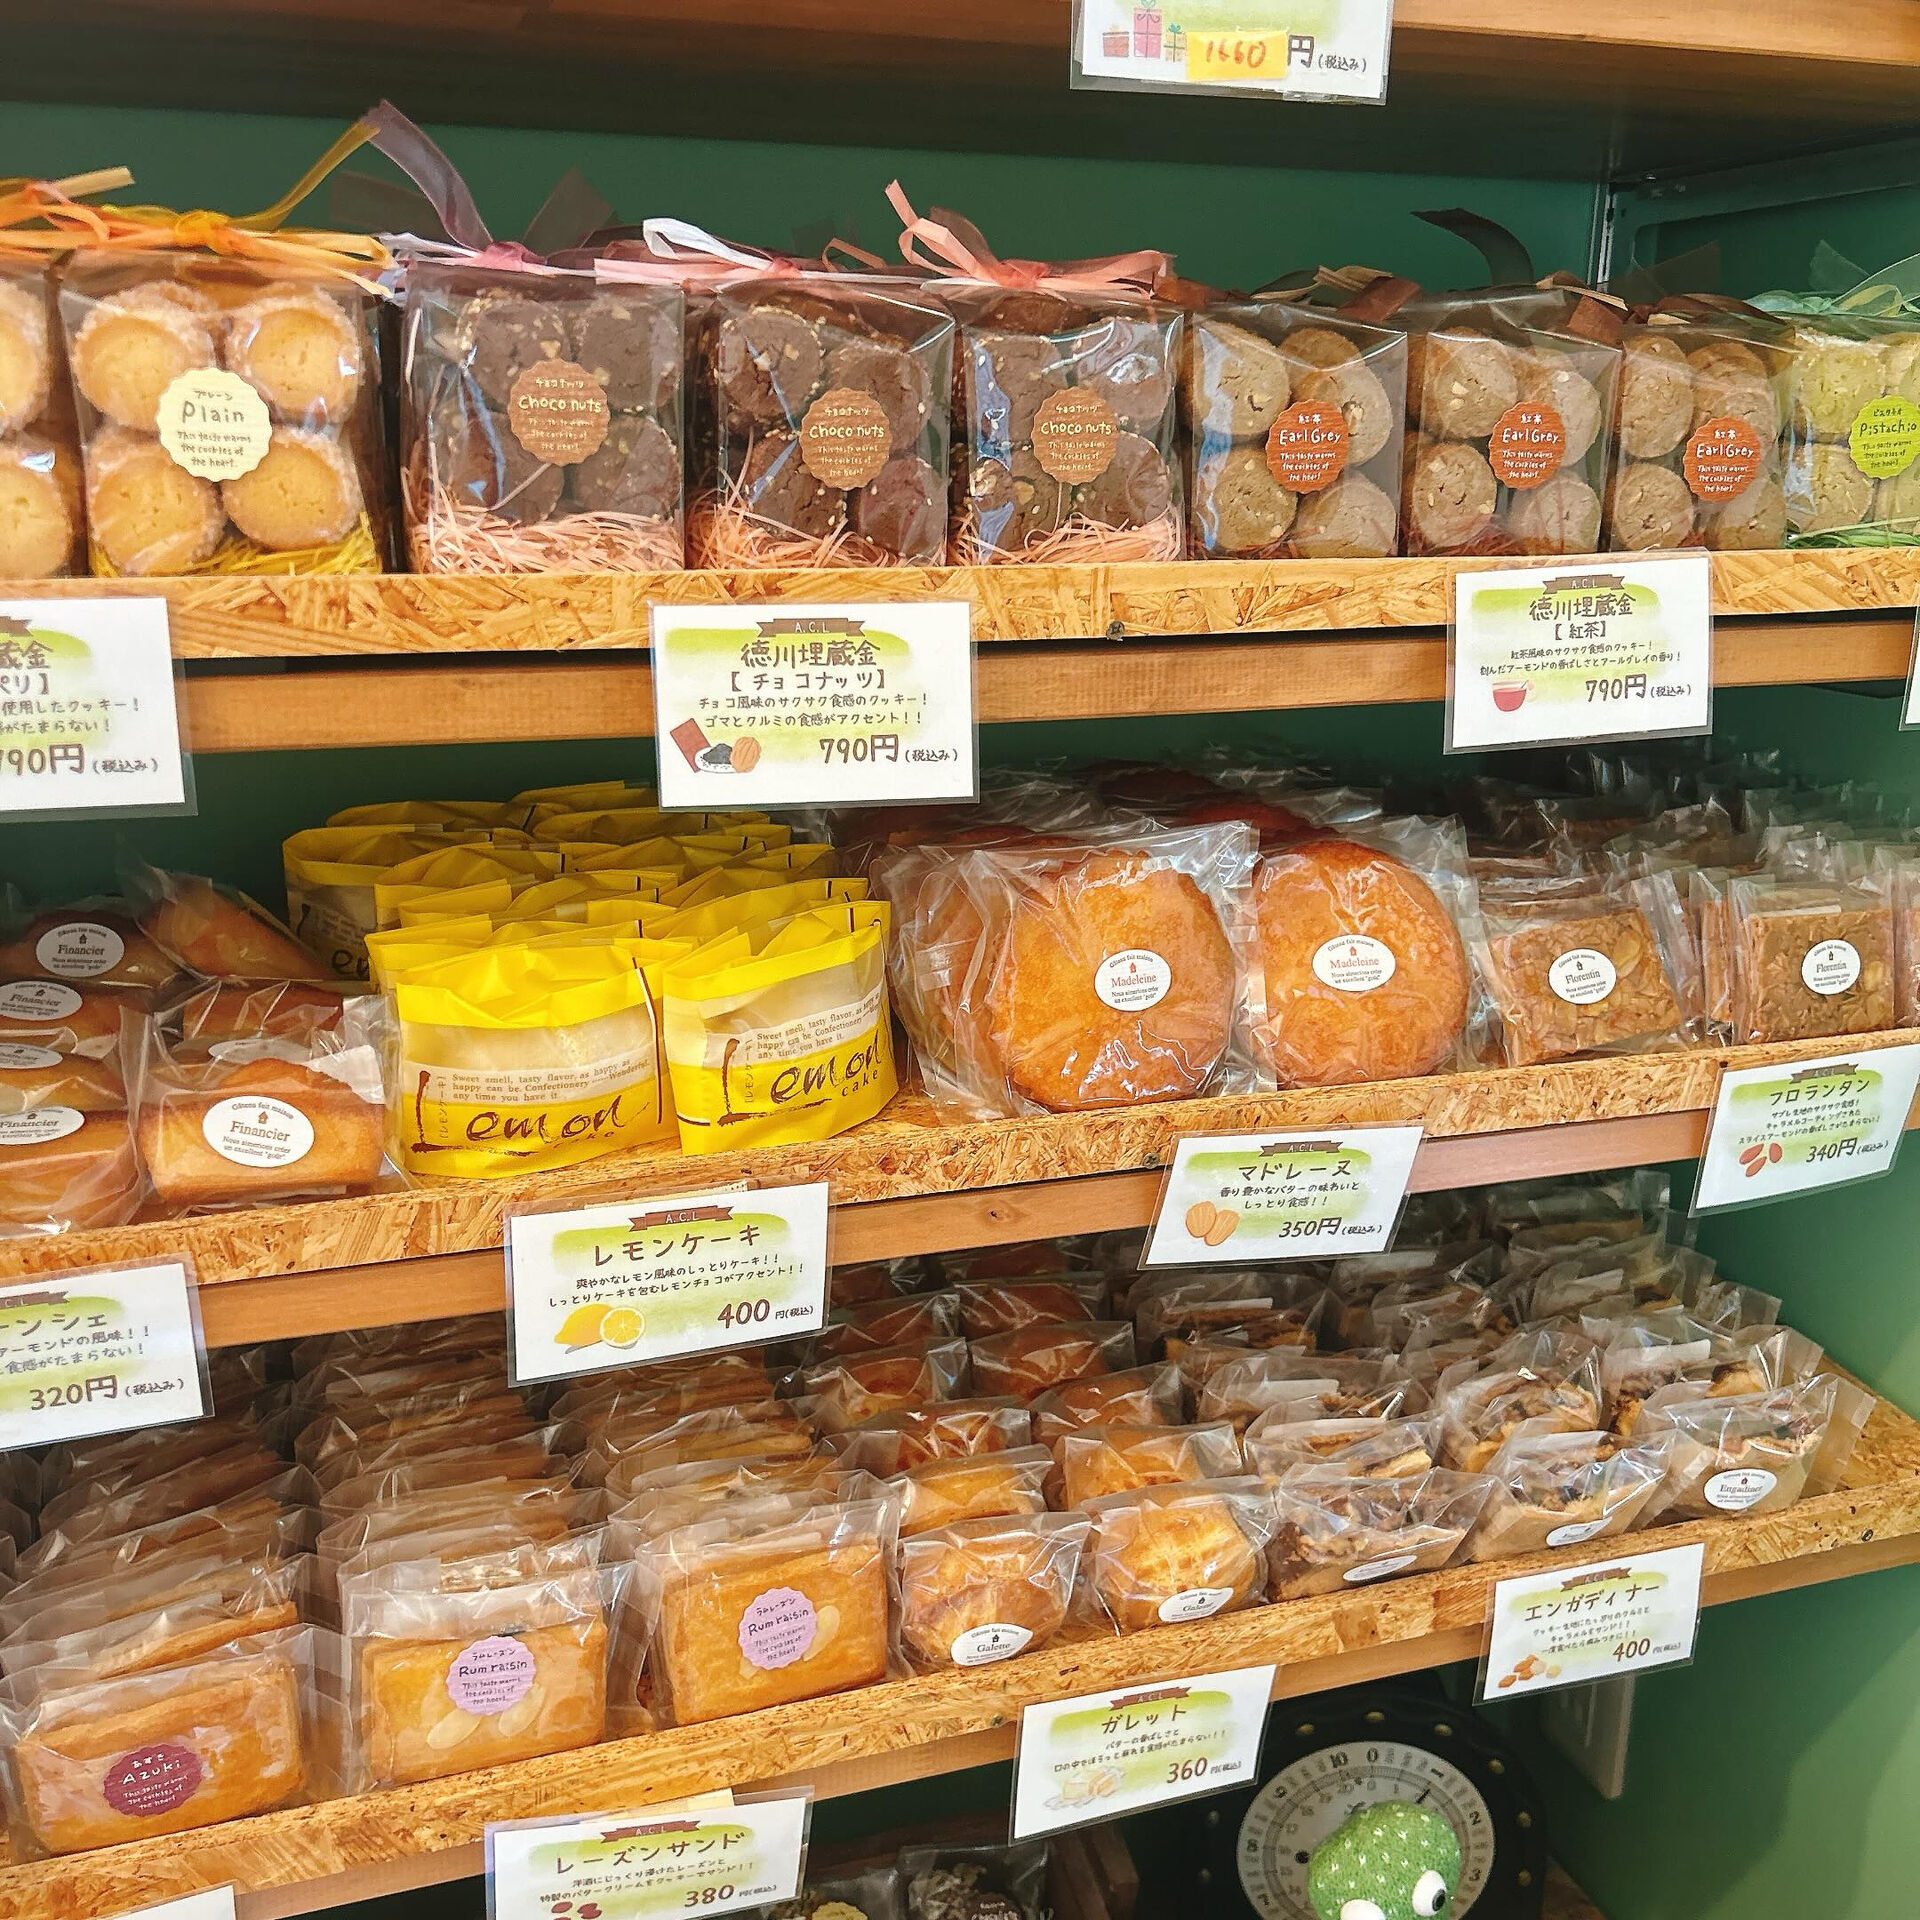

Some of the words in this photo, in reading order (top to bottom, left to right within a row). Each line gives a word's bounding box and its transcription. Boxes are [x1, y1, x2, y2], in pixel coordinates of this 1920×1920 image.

[182, 400, 245, 423] Plain
[571, 398, 602, 413] nuts
[857, 424, 884, 438] nuts
[1085, 421, 1112, 435] nuts
[1279, 428, 1308, 445] Earl
[1311, 428, 1342, 444] Grey
[1502, 427, 1529, 443] Earl
[1531, 428, 1560, 444] Grey
[1860, 420, 1917, 437] Pistachio
[1696, 442, 1724, 458] Earl
[1725, 443, 1755, 458] Grey
[1528, 593, 1637, 623] 徳川埋蔵金
[1555, 620, 1607, 641] 【紅茶】
[740, 639, 881, 669] 徳川埋蔵金
[699, 692, 929, 710] チョコ風味のサクサク食感のクッキー！
[0, 719, 110, 734] がたまらない！
[703, 711, 923, 729] ゴマとクルミの食感がアクセント！！
[1329, 958, 1380, 969] Madeleine
[1111, 974, 1157, 988] Madeleine
[757, 1032, 782, 1040] Sweet
[808, 1017, 827, 1029] tasty
[757, 1040, 784, 1051] happy
[788, 1037, 800, 1047] can
[757, 1050, 774, 1060] any
[778, 1047, 798, 1057] time
[816, 1036, 834, 1047] have
[452, 1073, 480, 1083] Sweet
[519, 1074, 542, 1084] tasty
[580, 1071, 590, 1080] as
[452, 1083, 482, 1095] happy
[487, 1085, 503, 1093] can
[525, 1080, 590, 1093] Confectionery
[841, 1068, 879, 1098] cake
[453, 1092, 469, 1101] any
[474, 1092, 496, 1101] time
[501, 1094, 519, 1102] you
[523, 1093, 547, 1102] have
[1770, 1080, 1870, 1106] フロランタン
[230, 1120, 291, 1142] Financier
[1238, 1159, 1352, 1183] マドレーヌ
[1244, 1196, 1328, 1209] しっとり食感！！
[594, 1224, 761, 1267] レモンケーキ
[576, 1253, 779, 1290] 爽やかなレモン風味のしっとりケーキ！！
[717, 1298, 770, 1330] 400
[1524, 1583, 1660, 1622] エンガディナー
[748, 1620, 774, 1637] Rum
[776, 1608, 810, 1626] raisin
[1613, 1637, 1652, 1663] 400
[459, 1665, 488, 1678] Rum
[490, 1660, 528, 1673] raisin
[1101, 1704, 1187, 1735] ガレット
[1166, 1756, 1208, 1784] 360
[556, 1831, 745, 1875] レーズンサンド
[683, 1884, 736, 1908] 380
